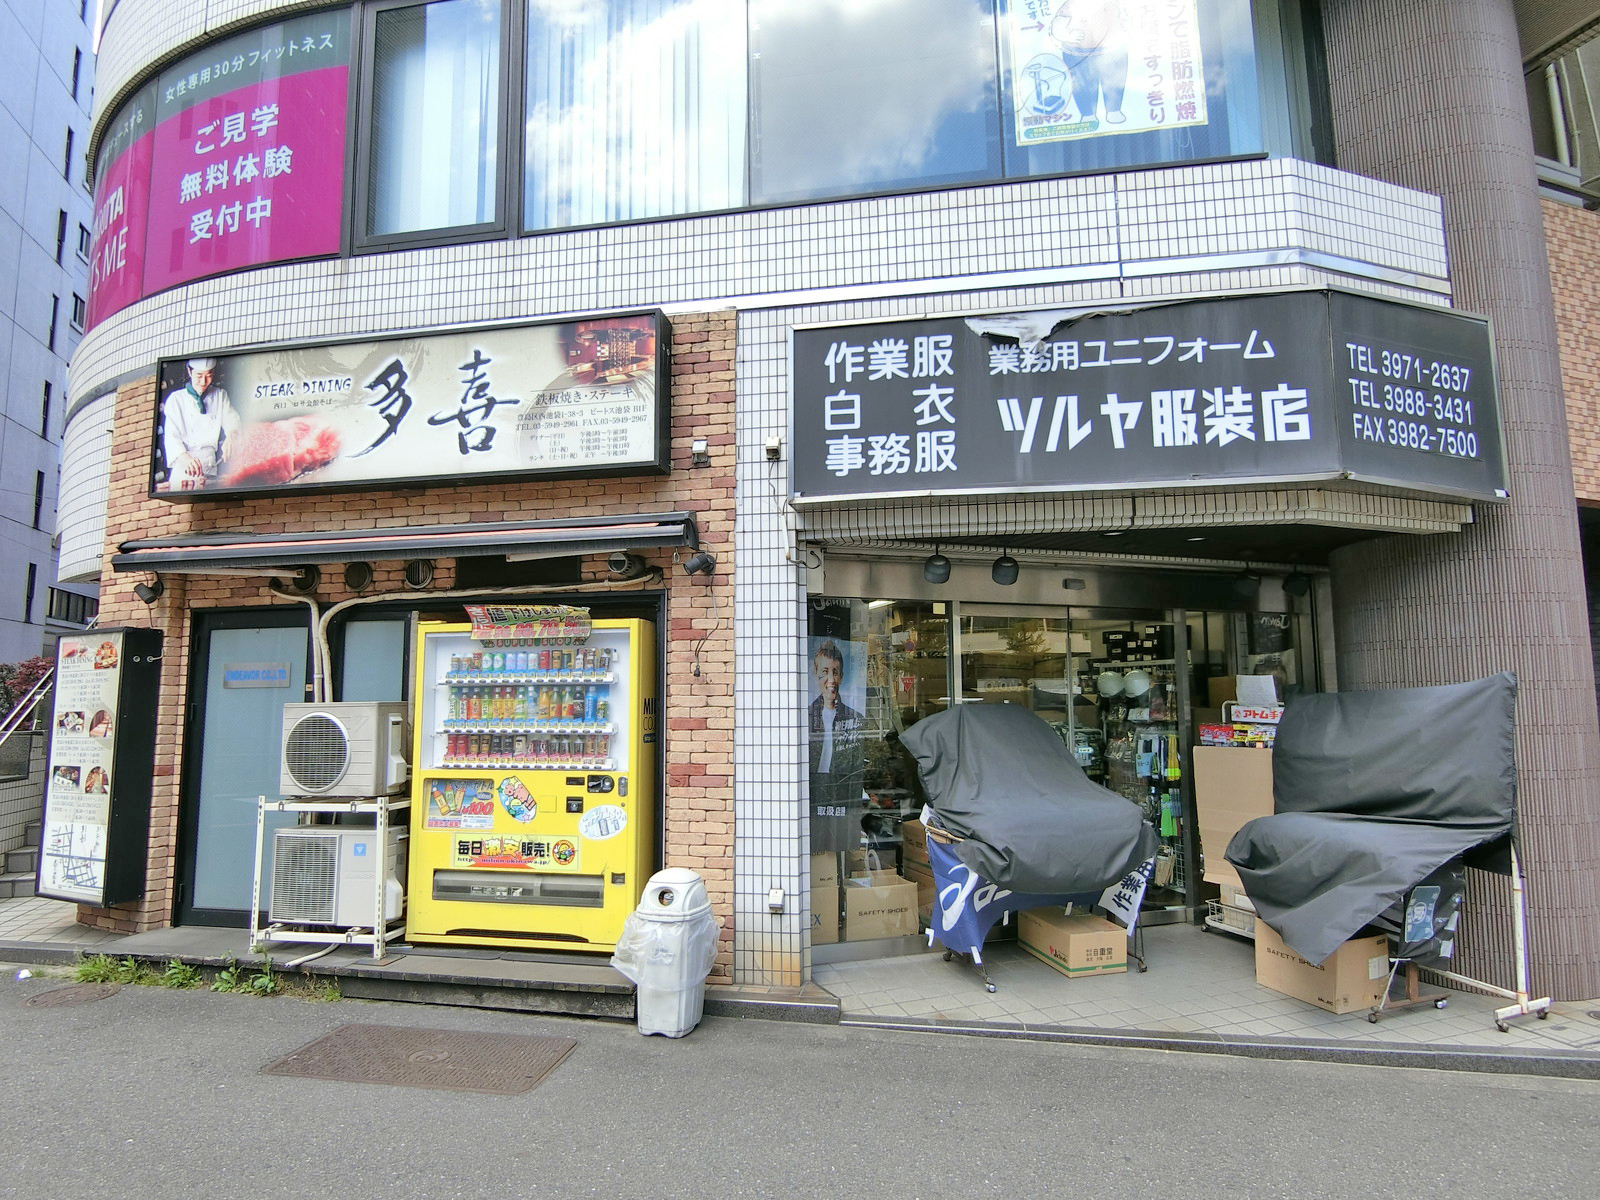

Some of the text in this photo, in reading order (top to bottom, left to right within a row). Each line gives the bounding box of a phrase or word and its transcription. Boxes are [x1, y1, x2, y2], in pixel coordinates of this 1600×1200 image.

[164, 33, 334, 104] 女性専用30分フィットネス
[193, 102, 280, 156] ご見学
[178, 144, 294, 206] 無料体験
[188, 194, 273, 246] 受付中
[102, 226, 129, 284] ME
[823, 333, 956, 384] 作業服
[987, 328, 1276, 376] 業務用ユニフォーム
[1346, 342, 1470, 393] TEL 3971-2637
[254, 376, 353, 400] STEAK DINING
[534, 386, 634, 407] 鉄板焼き・ステーキ
[1348, 377, 1473, 425] TEL 3988-3431
[996, 382, 1311, 454] ツルヤ服装店
[1352, 413, 1478, 459] FAX 3982-7500
[824, 430, 959, 478] 事務服
[541, 637, 572, 647] SHOP
[858, 906, 909, 917] SAFETY SHOES
[1265, 946, 1297, 962] SAFETY
